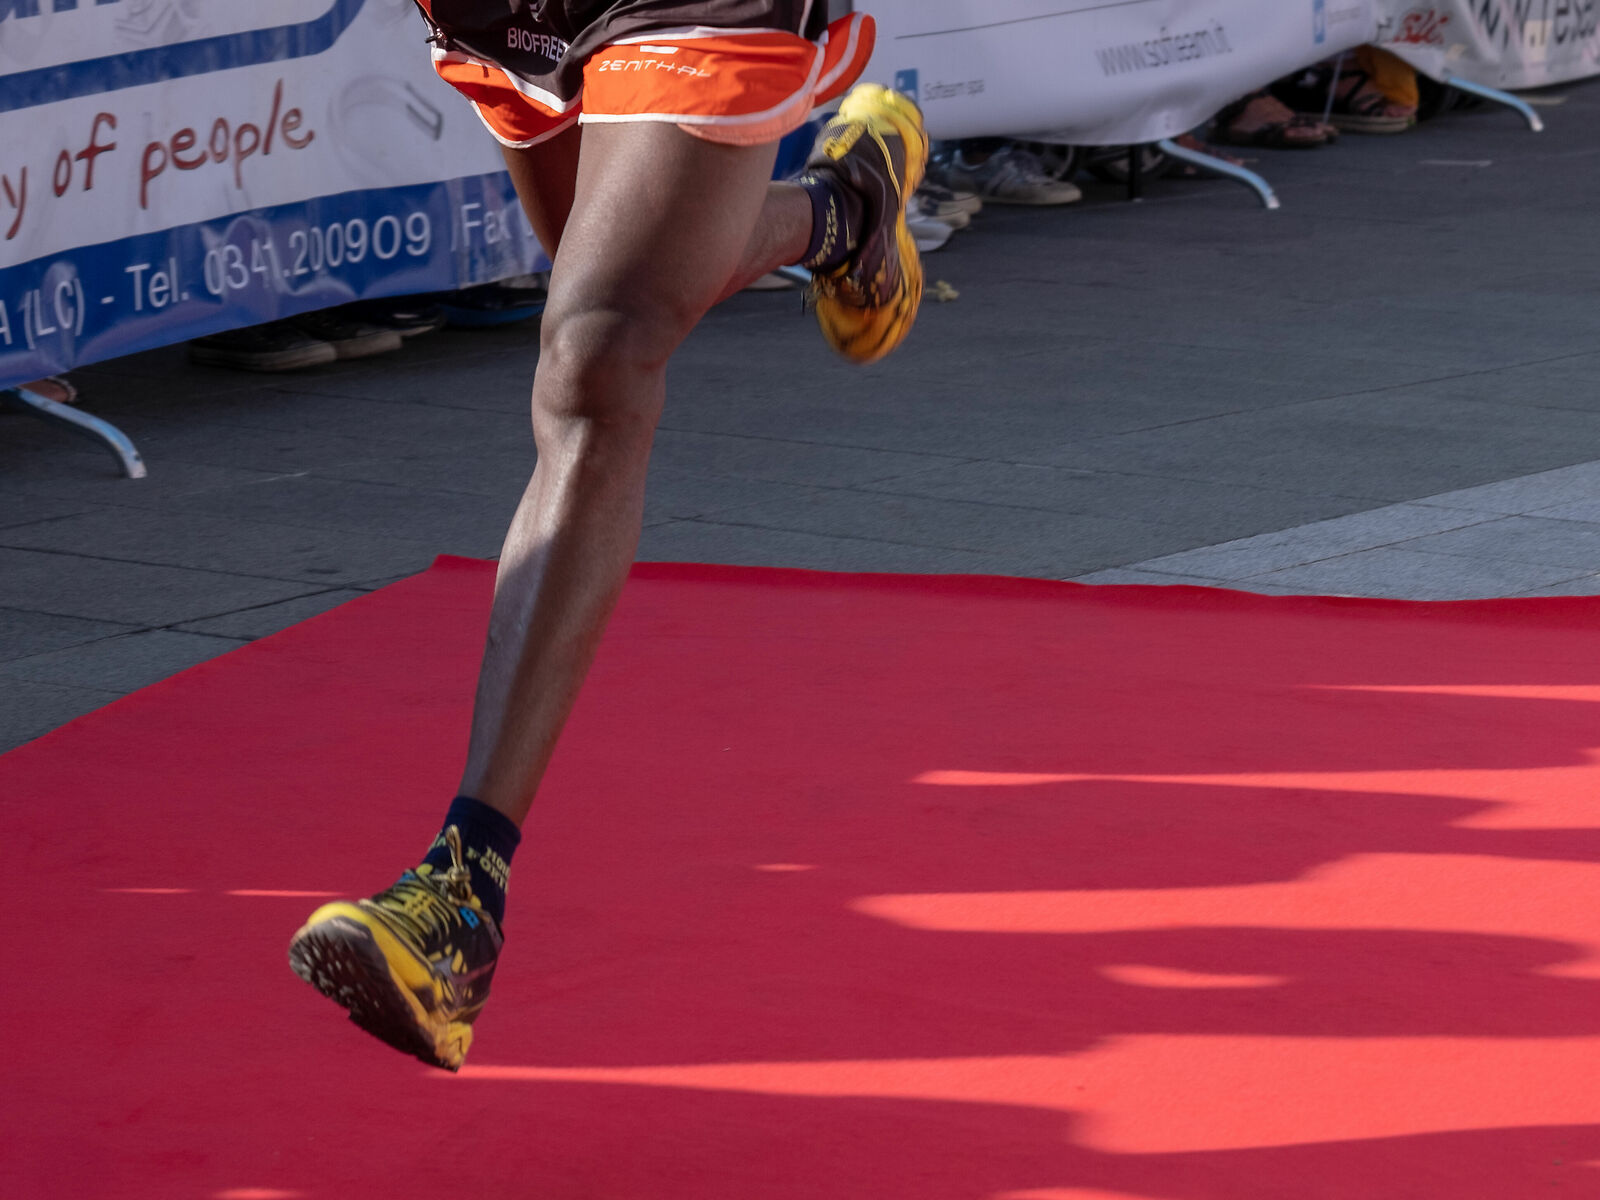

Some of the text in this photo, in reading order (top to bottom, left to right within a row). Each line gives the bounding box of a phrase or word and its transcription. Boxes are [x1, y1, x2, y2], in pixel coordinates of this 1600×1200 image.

[599, 58, 711, 78] ZENITHAL
[53, 112, 117, 197] of
[139, 78, 315, 210] people
[23, 277, 85, 350] (LC)
[125, 257, 189, 312] Tel.
[204, 212, 431, 295] 0341.200909
